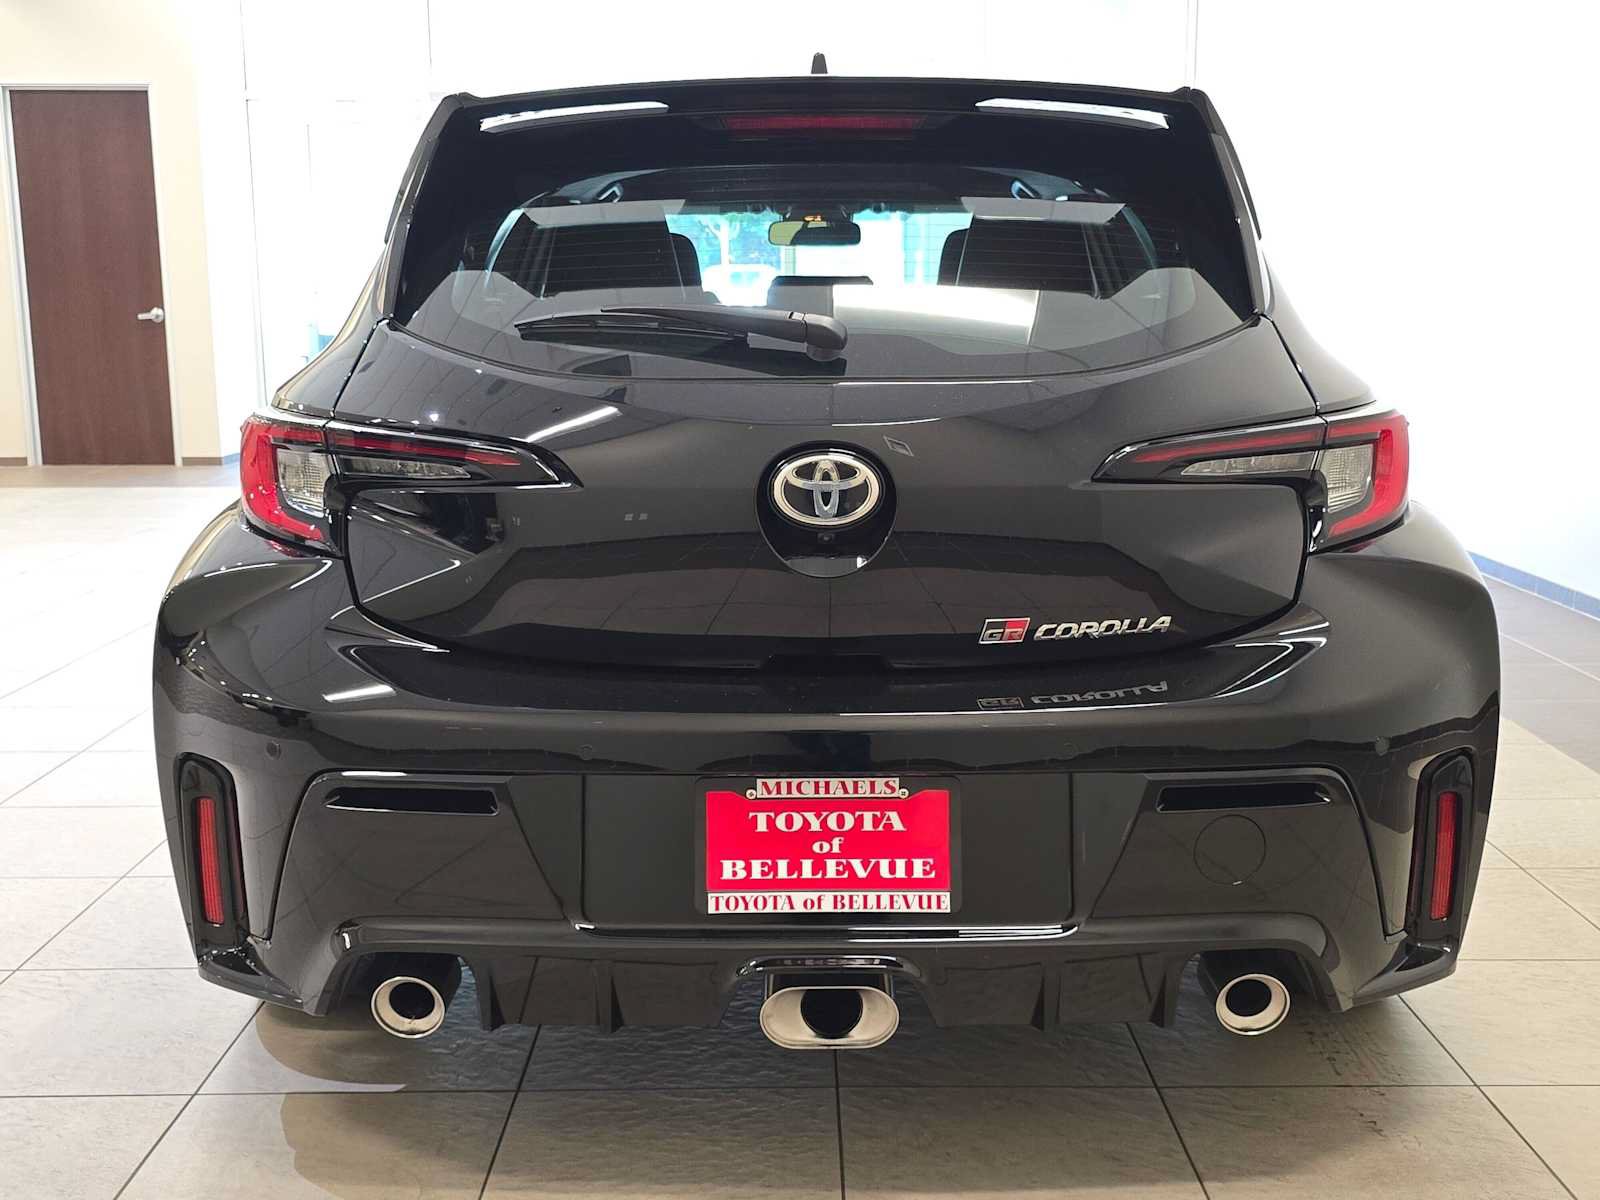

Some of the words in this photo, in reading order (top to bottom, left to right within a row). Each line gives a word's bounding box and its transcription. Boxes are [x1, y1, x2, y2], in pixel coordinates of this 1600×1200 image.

[1033, 615, 1172, 640] COROLLA
[760, 779, 898, 796] MICHAELS
[749, 811, 906, 832] TOYOTA
[812, 837, 844, 853] of
[720, 858, 936, 880] BELLEVUE
[710, 895, 796, 912] TOYOTA
[802, 895, 825, 911] of
[832, 894, 949, 910] BELLEVUE
